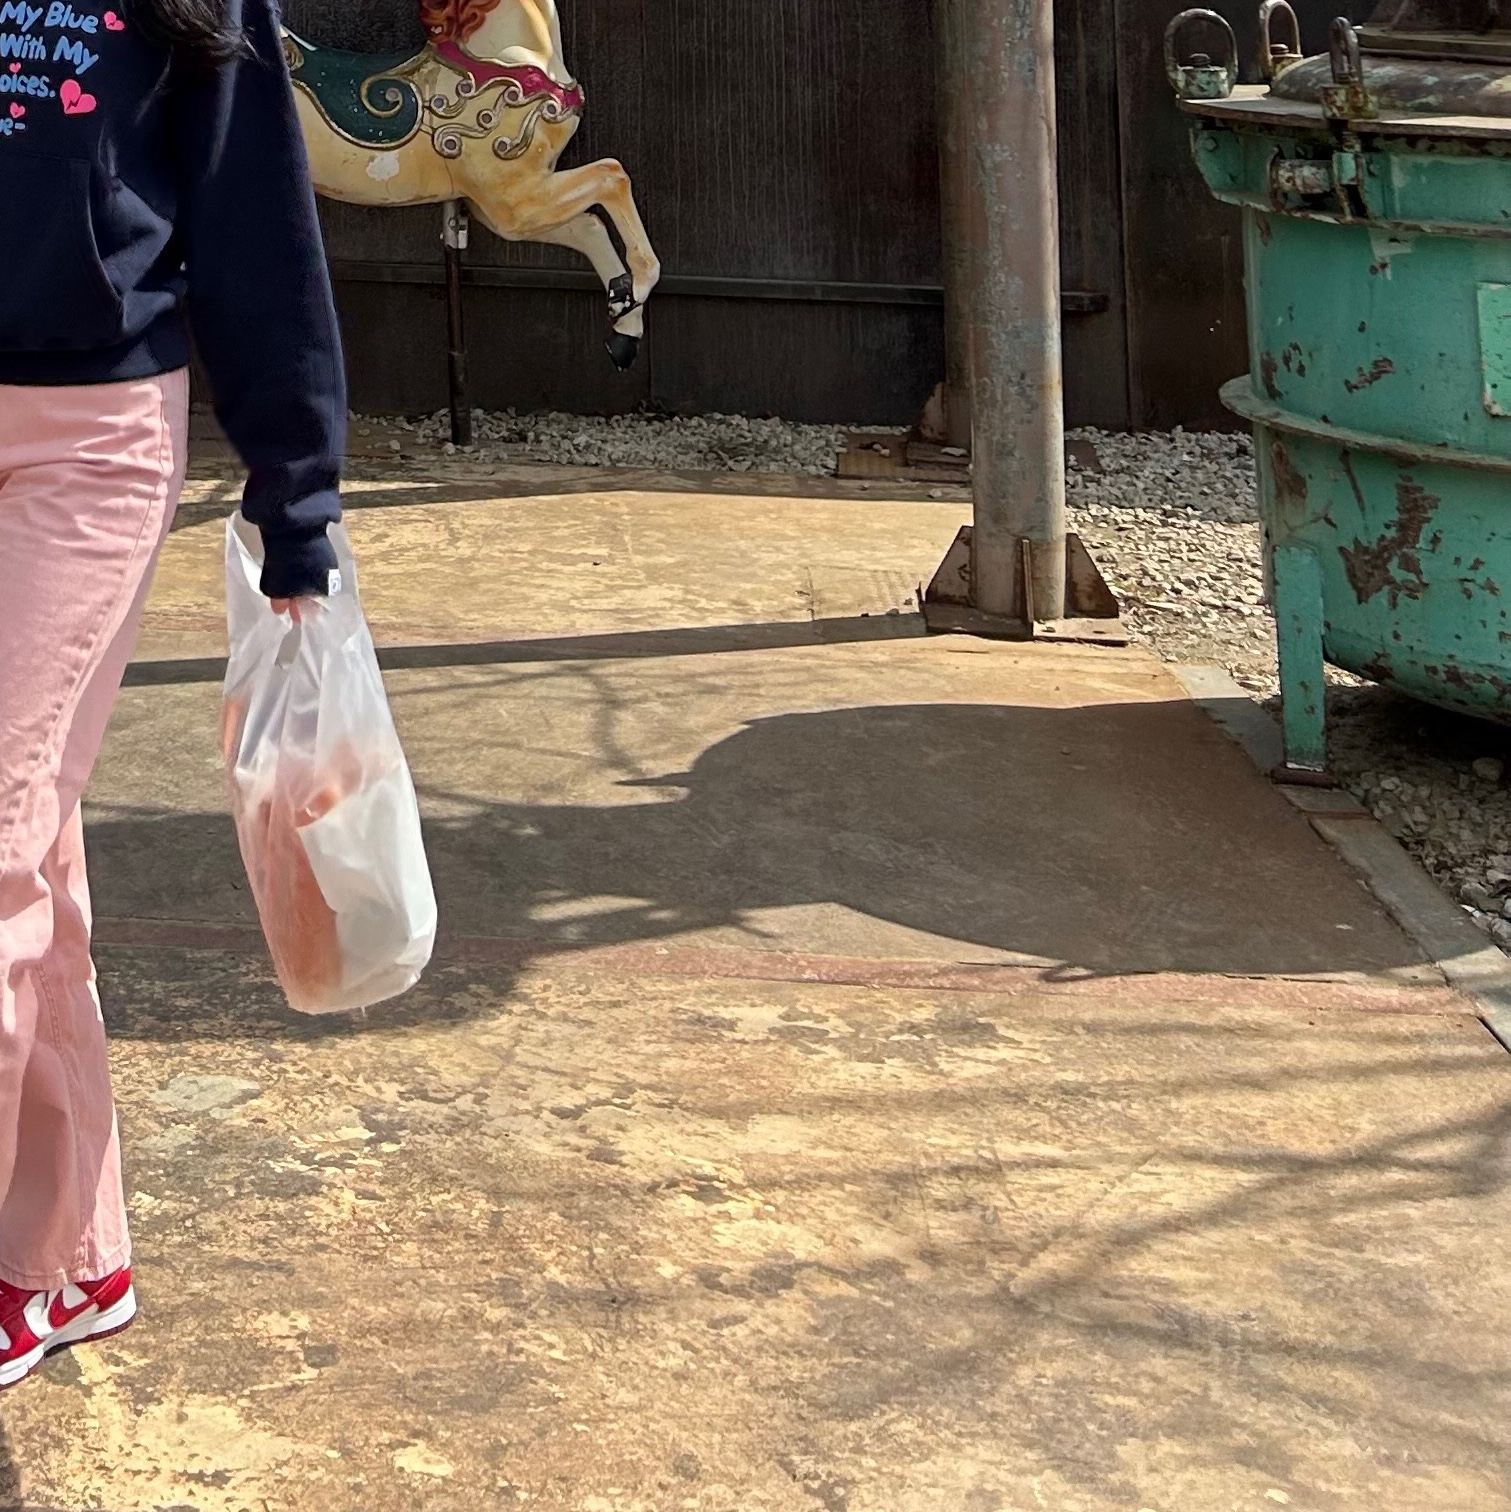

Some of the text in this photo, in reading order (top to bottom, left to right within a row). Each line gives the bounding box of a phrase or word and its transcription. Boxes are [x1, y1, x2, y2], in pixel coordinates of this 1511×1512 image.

[0, 0, 43, 32] My
[44, 1, 99, 33] Blue
[0, 32, 46, 60] With
[52, 36, 99, 75] My
